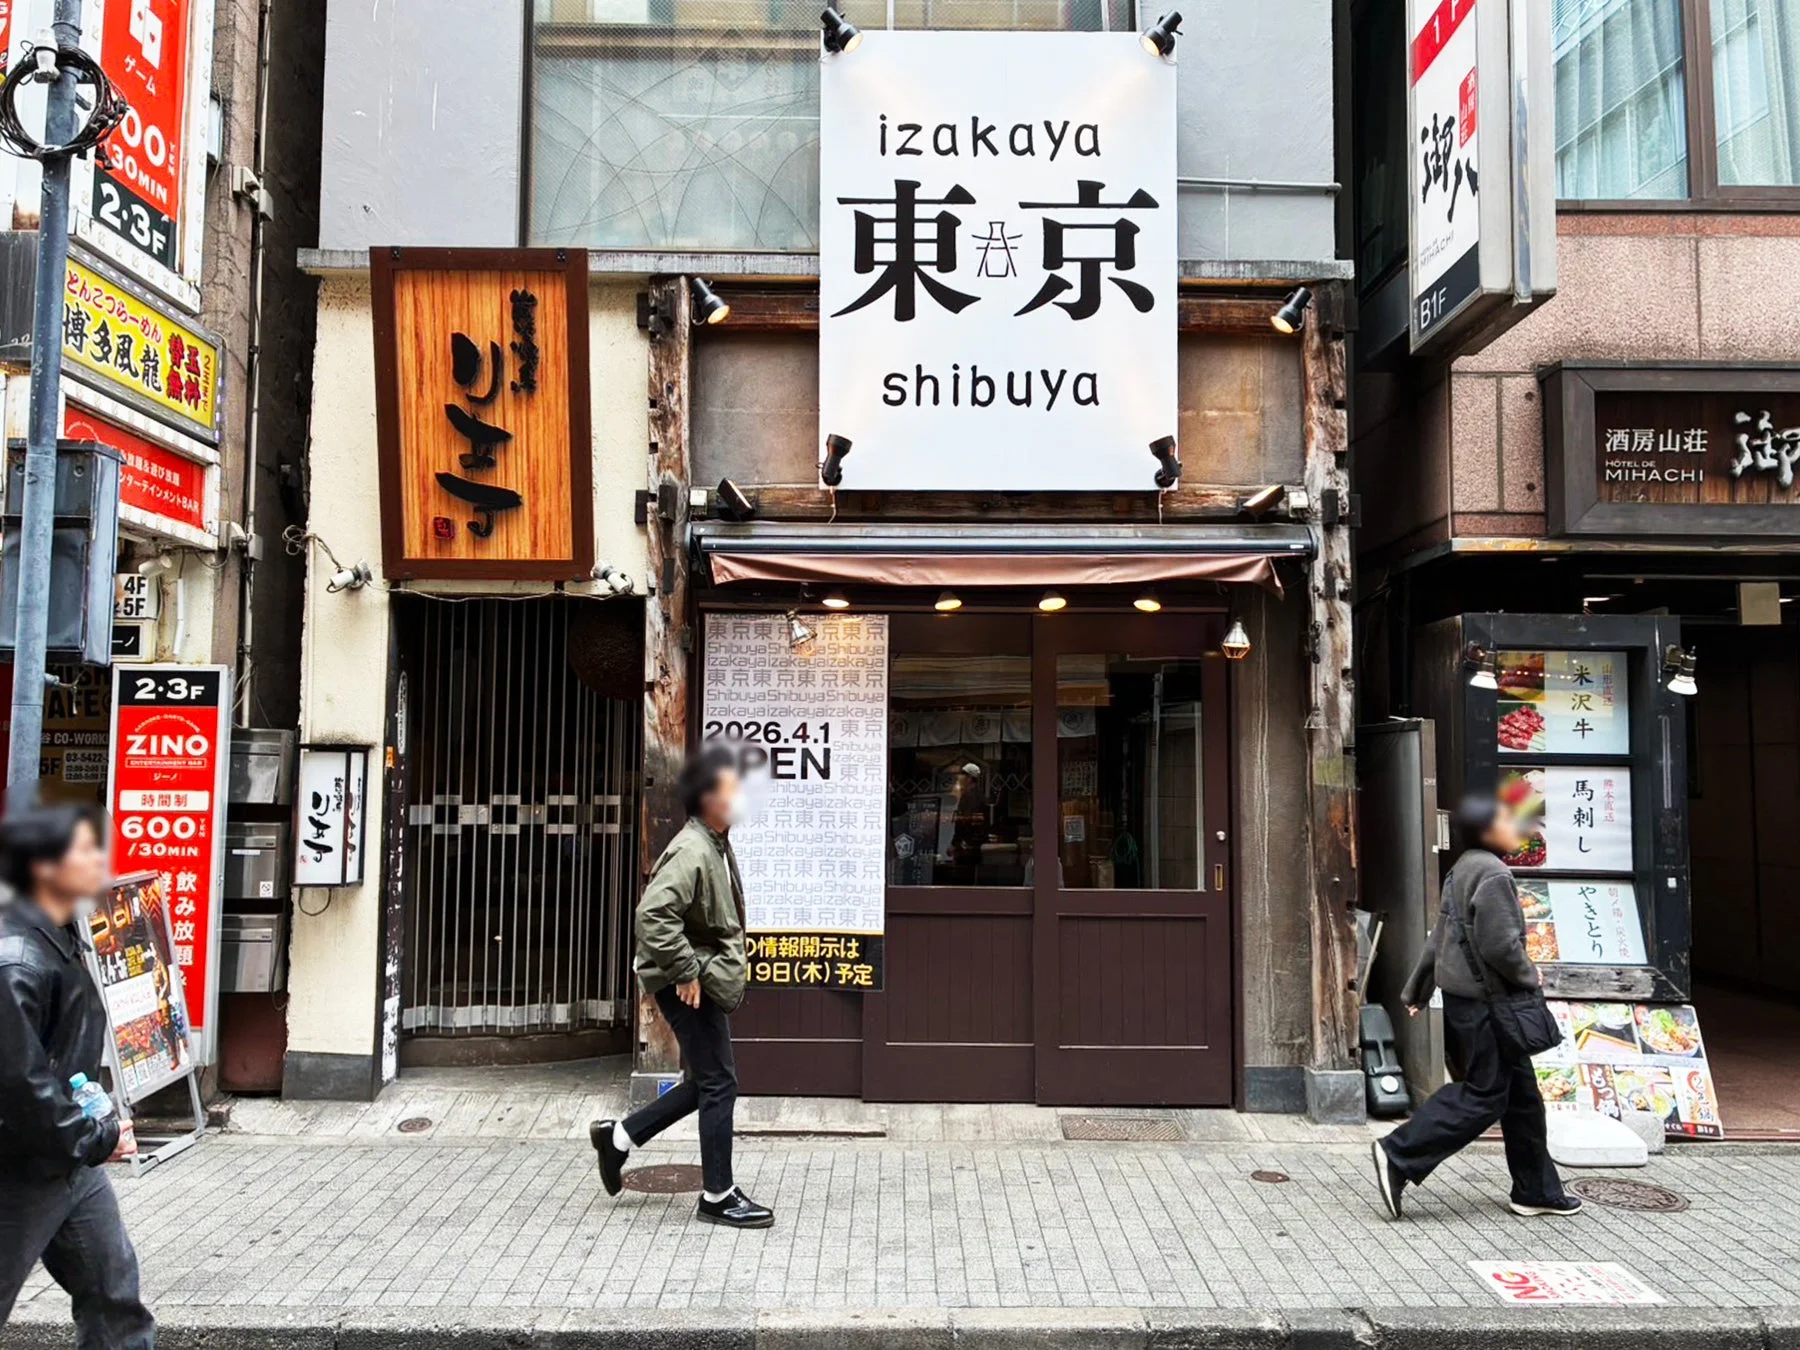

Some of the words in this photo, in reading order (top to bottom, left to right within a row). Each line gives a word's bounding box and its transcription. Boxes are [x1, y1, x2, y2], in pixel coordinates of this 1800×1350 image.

[123, 55, 157, 97] ゲーム
[120, 105, 166, 167] 00
[879, 114, 1101, 161] izakaya
[831, 179, 1159, 321] 東京
[66, 269, 163, 344] とんこつらーめん
[1420, 287, 1447, 329] B1F
[63, 302, 163, 393] 博多風龍
[882, 364, 1099, 411] shibuya
[1606, 428, 1709, 453] 酒房山荘
[1605, 469, 1704, 482] MIHACHI
[124, 576, 146, 594] 4F
[1571, 665, 1594, 740] 米沢牛
[126, 734, 209, 757] ZINO
[705, 721, 830, 744] 2026.4.1
[841, 720, 883, 738] 東京
[153, 773, 178, 781] ジーノ
[740, 747, 831, 780] PEN
[840, 763, 883, 782] 東京
[141, 794, 188, 808] 時間制
[1572, 779, 1594, 853] 馬刺し
[121, 816, 196, 839] 600
[128, 843, 199, 857] /30MIN
[1577, 886, 1603, 959] やきとり
